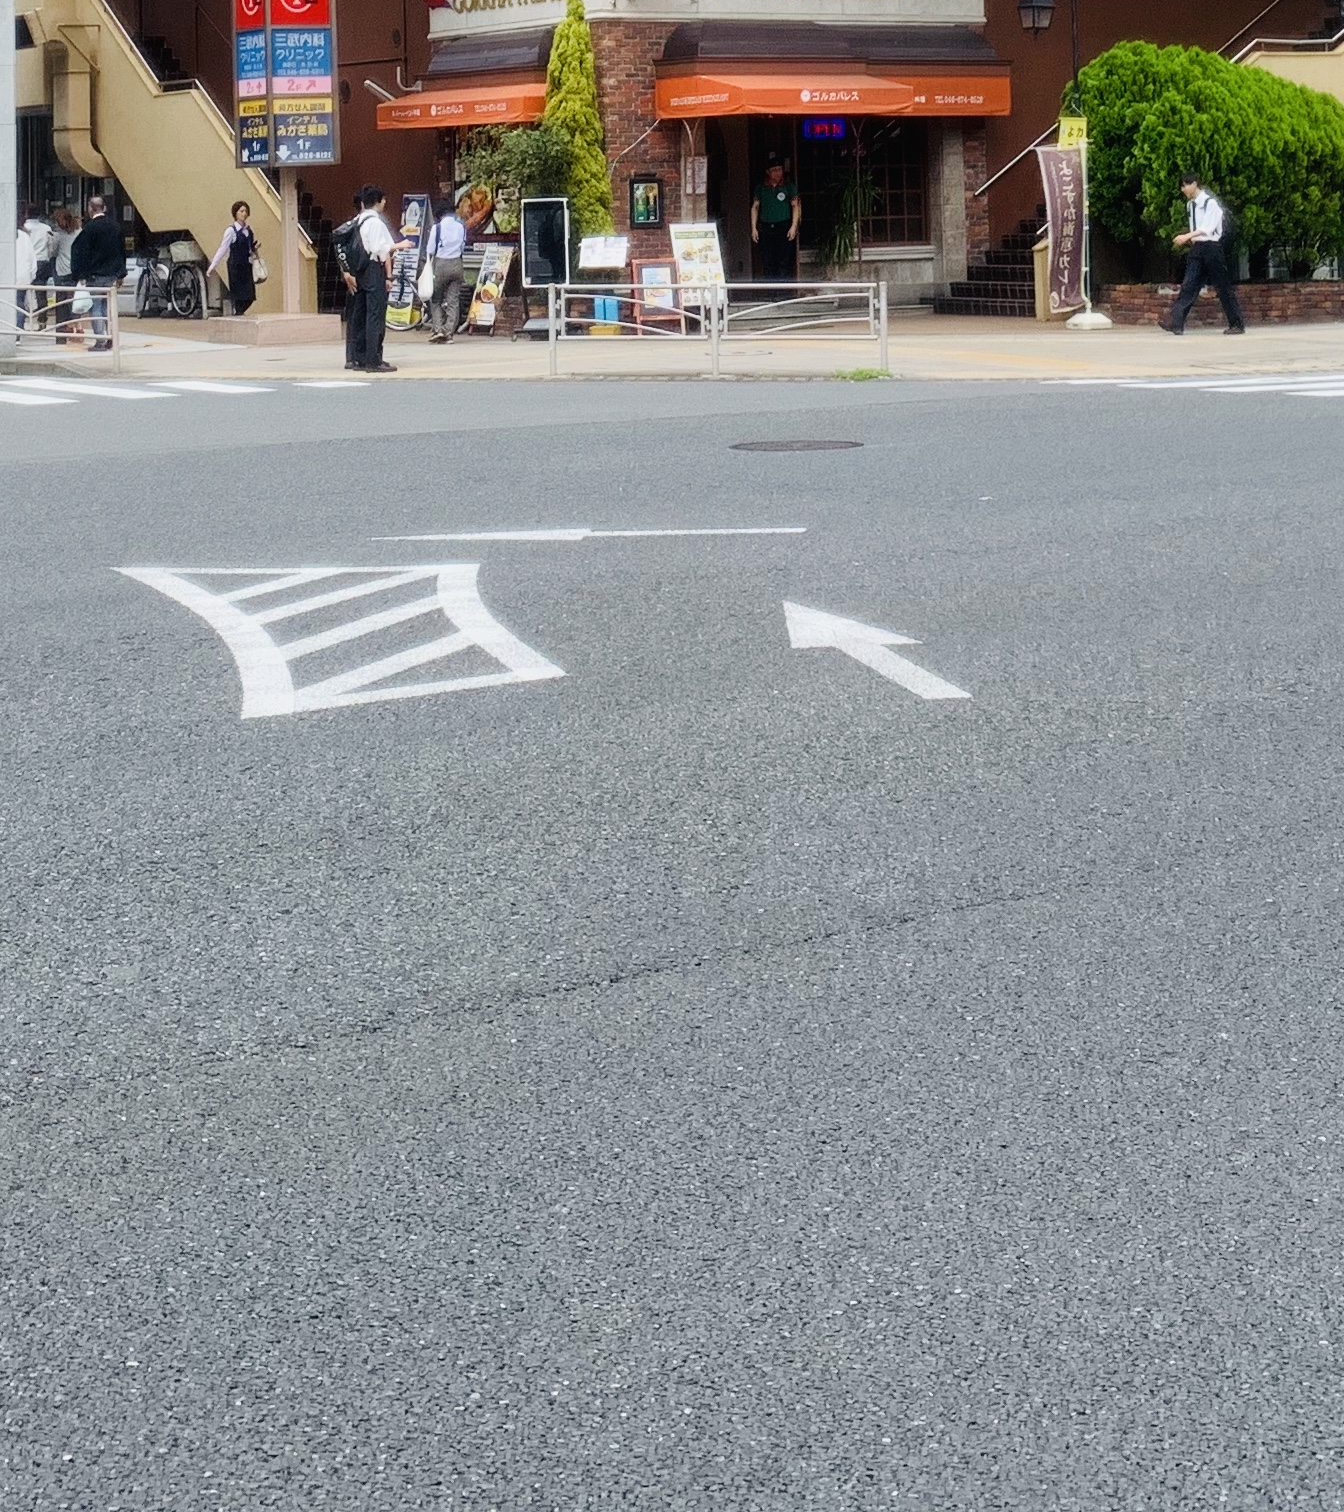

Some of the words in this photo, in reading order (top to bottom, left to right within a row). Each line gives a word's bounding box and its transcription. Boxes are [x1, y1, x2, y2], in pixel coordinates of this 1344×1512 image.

[276, 48, 325, 61] クリニック
[296, 138, 311, 150] 1F
